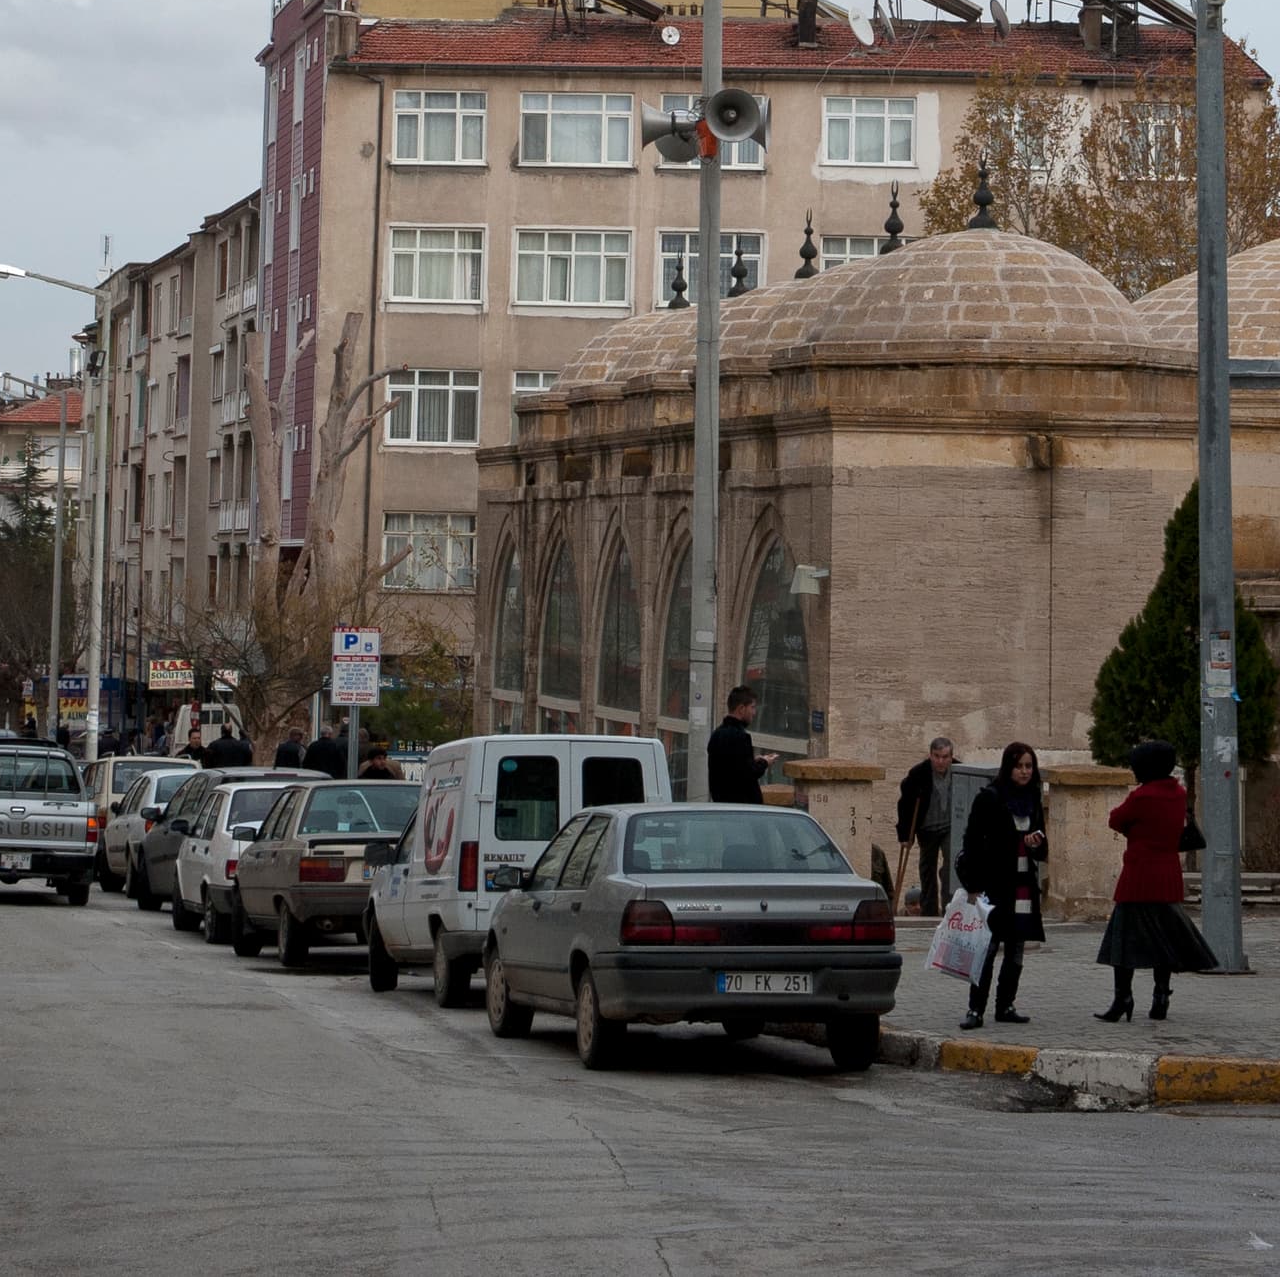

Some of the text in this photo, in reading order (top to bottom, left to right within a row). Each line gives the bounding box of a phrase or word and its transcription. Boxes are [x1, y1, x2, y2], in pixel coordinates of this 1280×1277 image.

[344, 634, 359, 650] P
[483, 853, 527, 863] RENAULT
[726, 974, 809, 992] 70 FK 251
